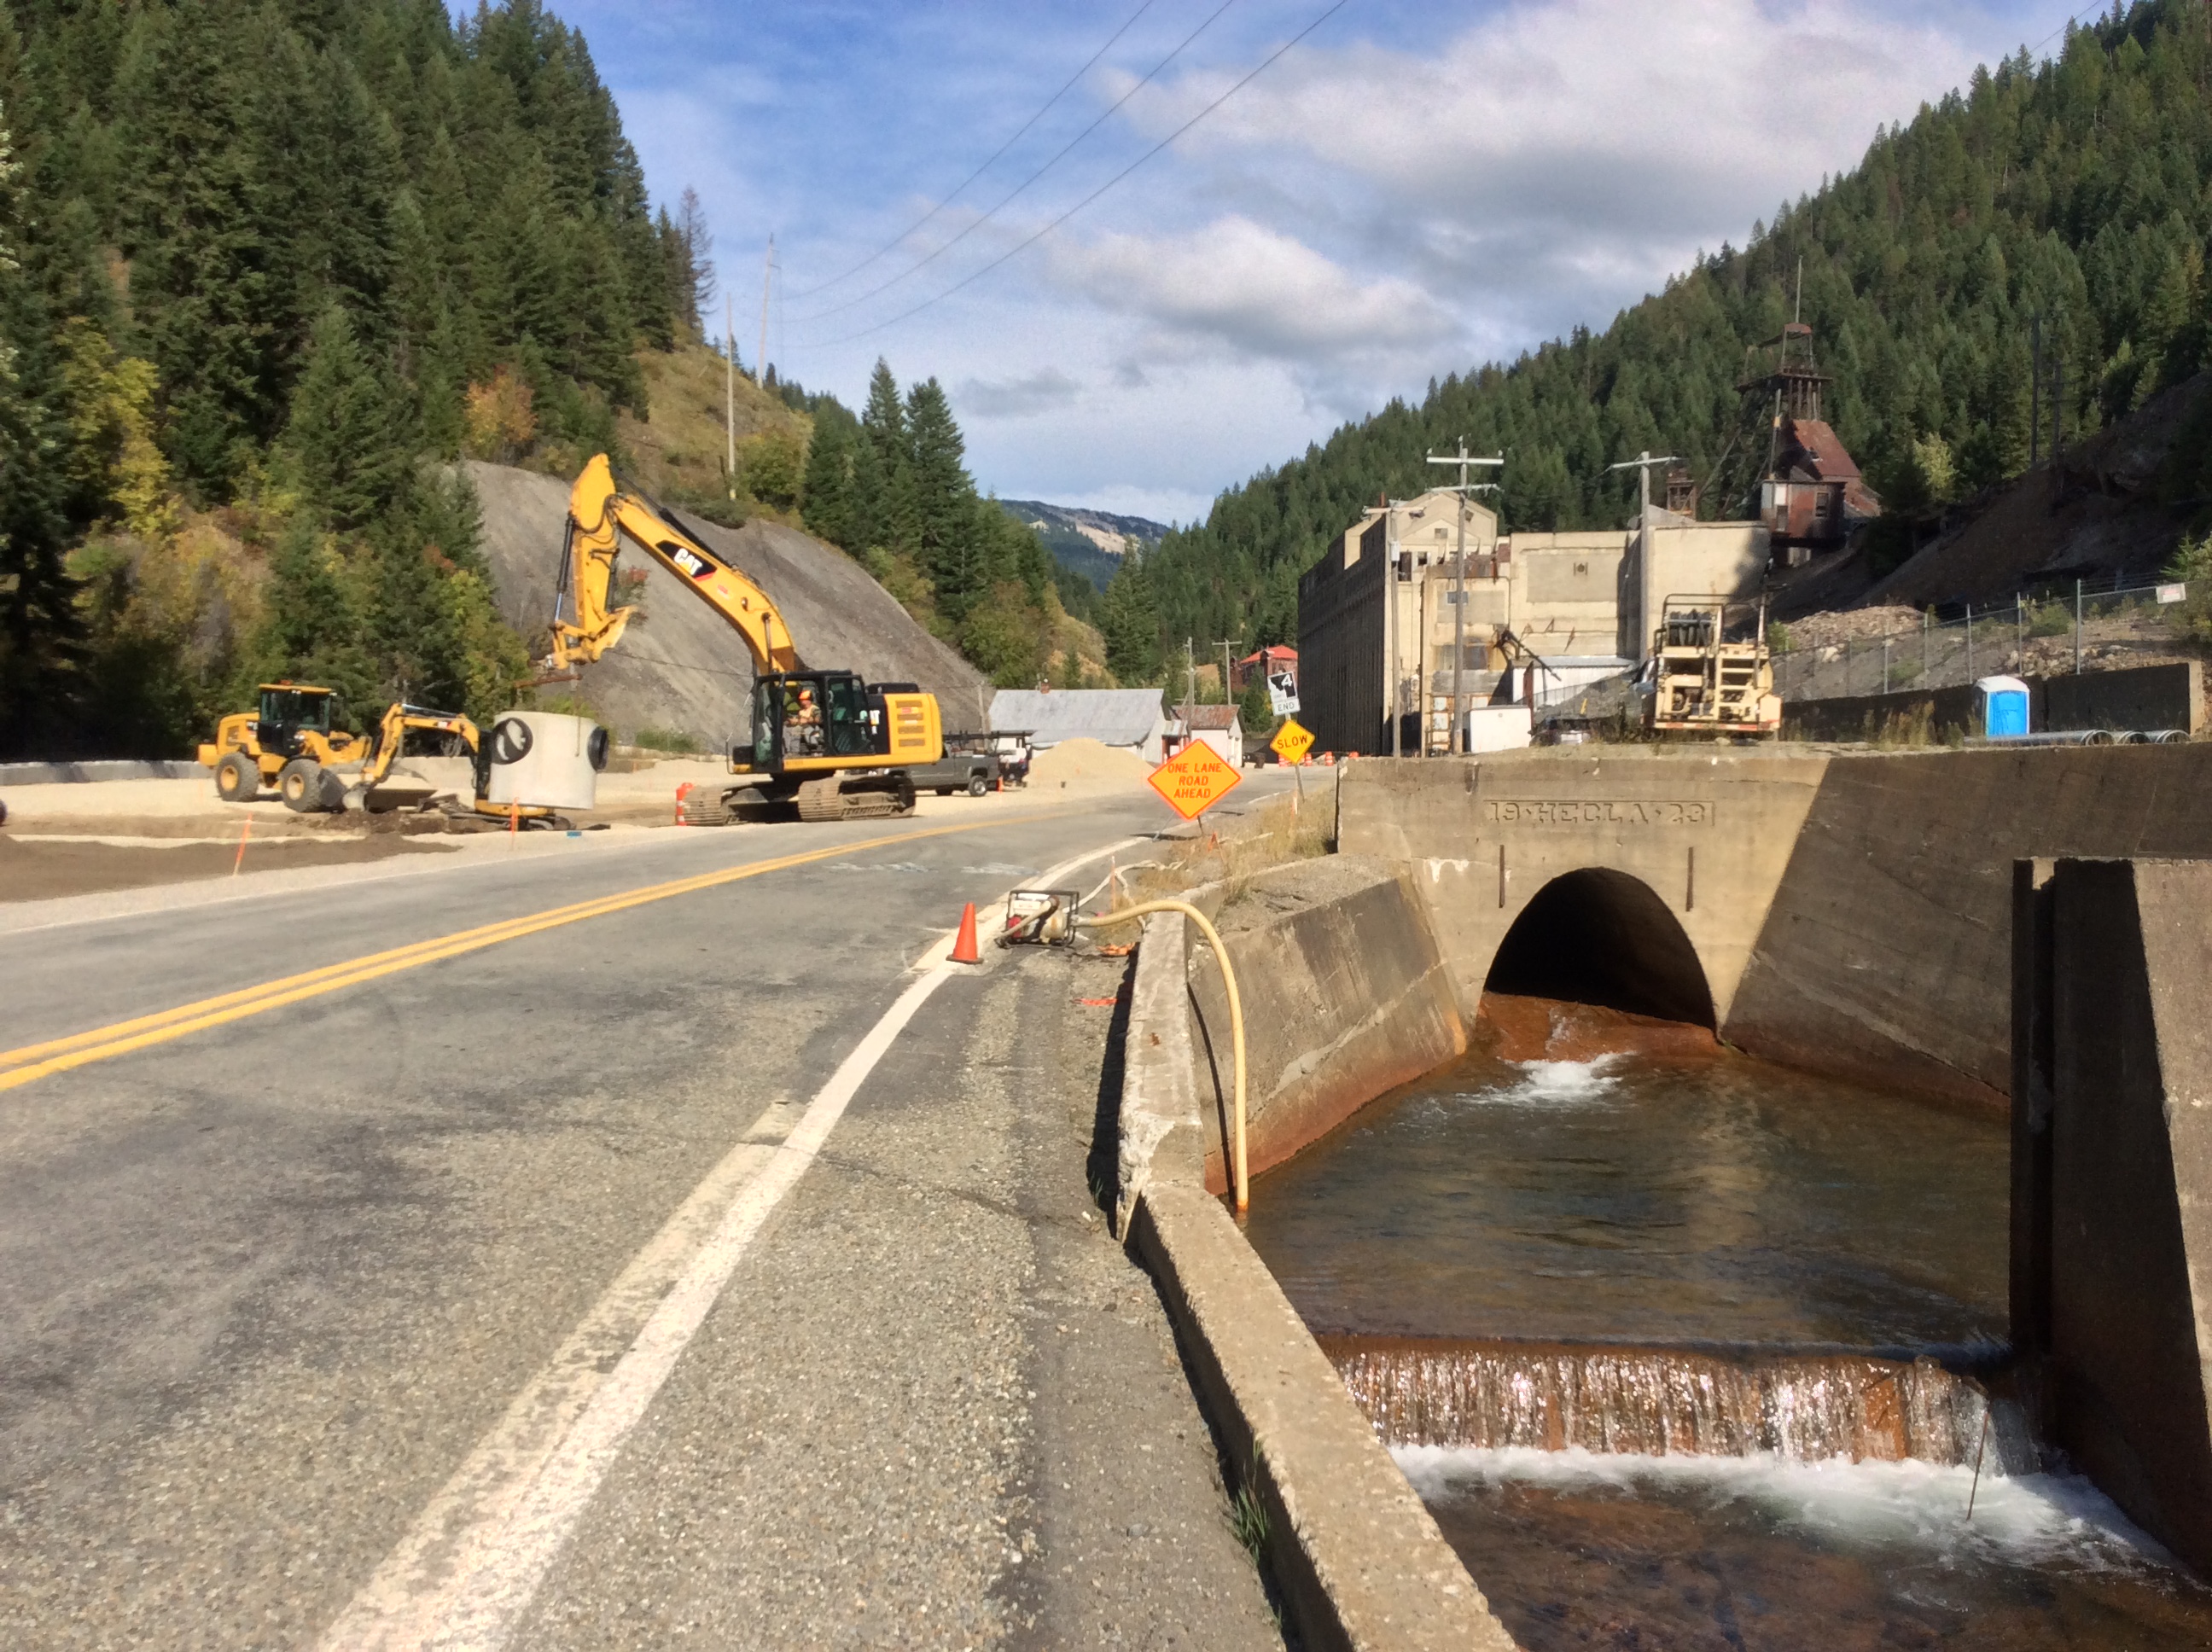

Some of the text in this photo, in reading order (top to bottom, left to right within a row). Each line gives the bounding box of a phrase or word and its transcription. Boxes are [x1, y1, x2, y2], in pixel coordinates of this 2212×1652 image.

[673, 548, 702, 575] CAT
[1281, 674, 1293, 686] 4
[1278, 701, 1295, 712] END
[1277, 735, 1307, 749] SLOW
[1167, 763, 1222, 774] ONE LANE
[1178, 776, 1209, 786] ROAD
[1173, 788, 1211, 799] AHEAD
